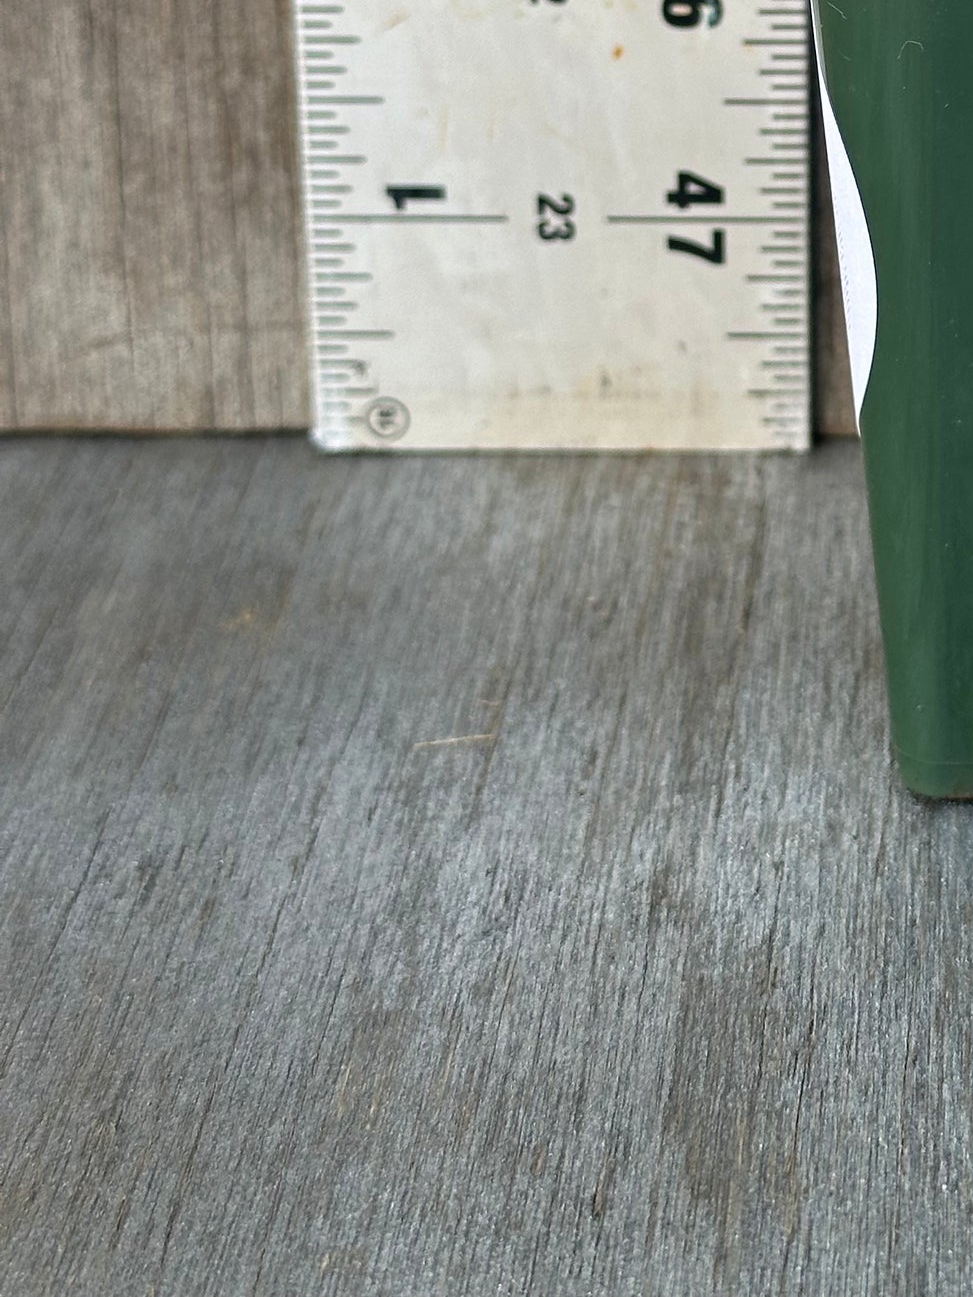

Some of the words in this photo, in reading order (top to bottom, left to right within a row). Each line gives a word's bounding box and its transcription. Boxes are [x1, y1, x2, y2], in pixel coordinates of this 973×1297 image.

[385, 185, 446, 211] 1
[536, 194, 576, 242] 23
[666, 170, 727, 265] 47
